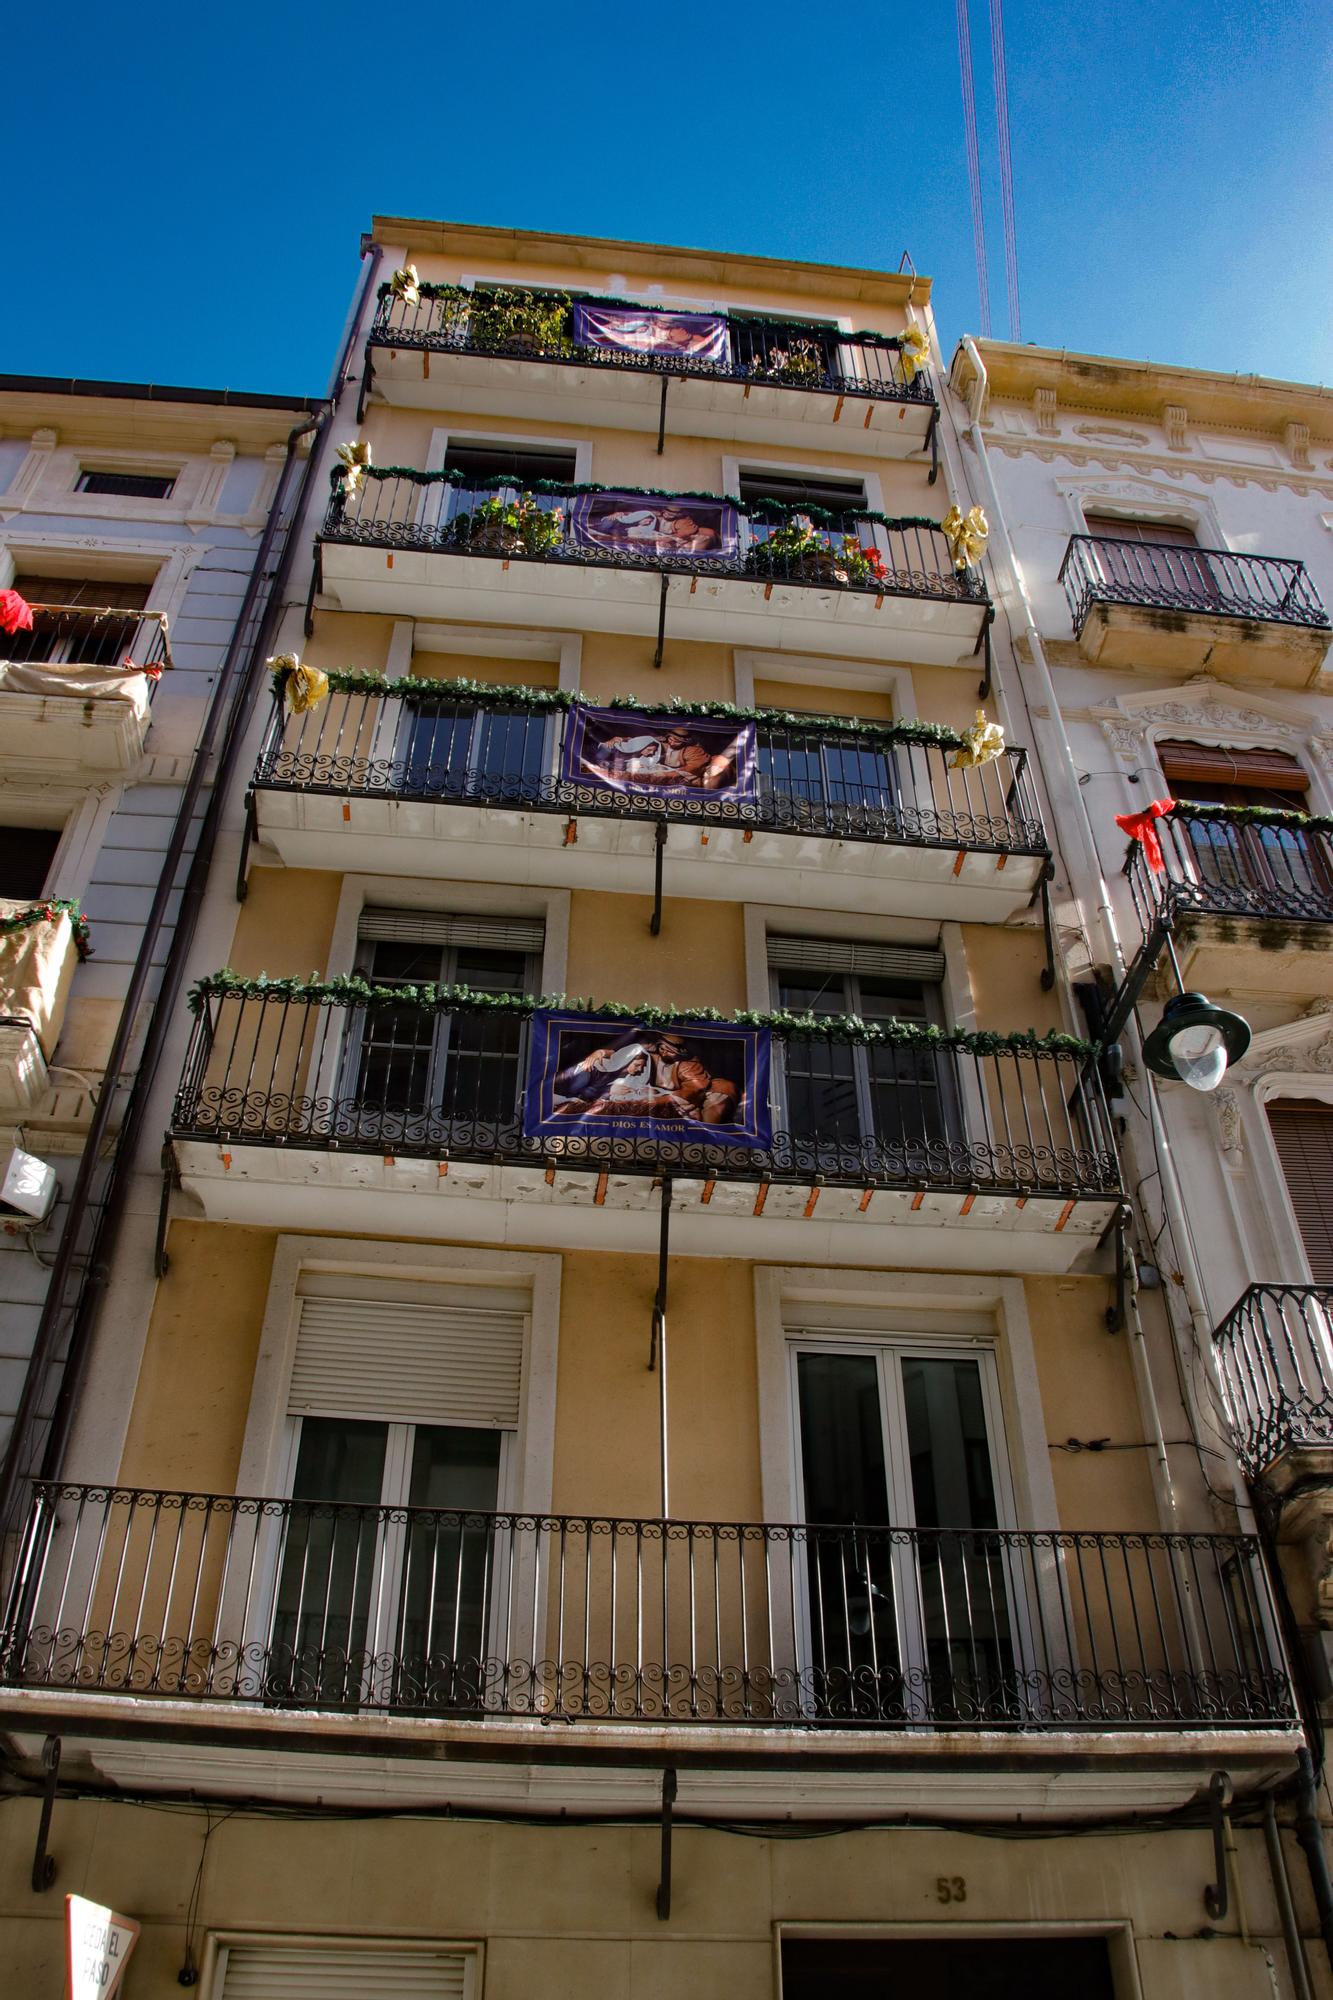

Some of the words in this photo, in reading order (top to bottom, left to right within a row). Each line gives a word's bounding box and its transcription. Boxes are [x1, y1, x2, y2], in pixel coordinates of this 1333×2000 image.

[612, 1120, 636, 1129] DIOS
[640, 1121, 652, 1129] ES
[655, 1123, 685, 1132] AMOR
[937, 1876, 967, 1904] 53
[108, 1931, 119, 1957] EL
[83, 1957, 110, 1986] PASO
